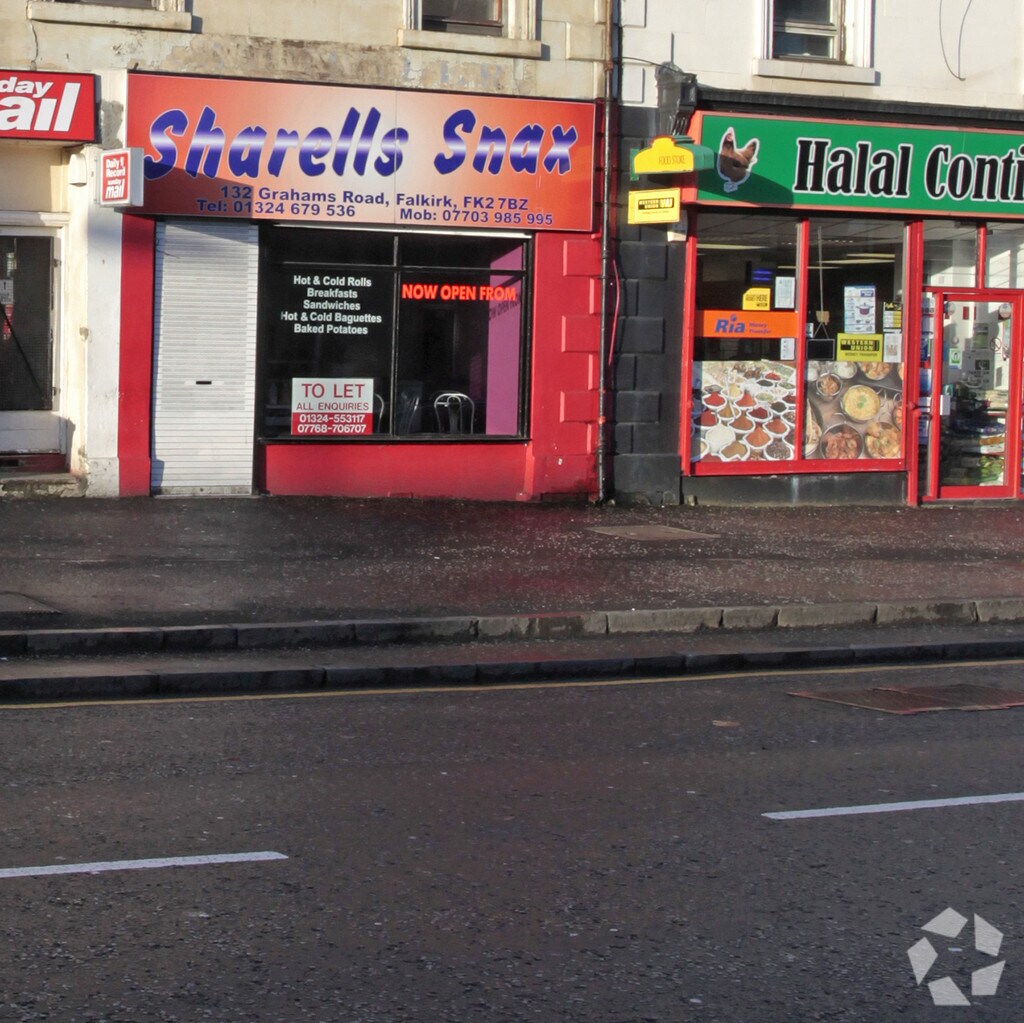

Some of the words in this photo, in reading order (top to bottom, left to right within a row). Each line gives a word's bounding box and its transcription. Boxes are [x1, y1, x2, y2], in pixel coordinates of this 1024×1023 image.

[144, 106, 410, 177] Sharells
[433, 108, 578, 175] Snax
[106, 157, 119, 169] Daily
[793, 137, 914, 198] Halal
[105, 178, 125, 199] mail
[221, 185, 253, 200] 132
[258, 186, 337, 205] Grahams
[342, 189, 390, 208] Road,
[396, 193, 457, 211] Falkirk,
[463, 195, 495, 210] FK2
[497, 197, 529, 211] 7BZ
[197, 199, 228, 213] Tel:
[233, 200, 285, 215] 01324
[290, 203, 321, 217] 679
[325, 204, 356, 218] 536
[400, 208, 437, 222] Mob:
[441, 209, 490, 224] 07703
[494, 211, 523, 225] 985
[526, 212, 554, 226] 995
[293, 275, 312, 286] Hot
[313, 276, 320, 286] &
[323, 276, 345, 287] Cold
[348, 277, 372, 288] Rolls
[307, 288, 358, 299] Breakfasts
[402, 284, 438, 300] NOW
[440, 284, 476, 301] OPEN
[479, 285, 517, 301] FROM
[303, 300, 361, 311] Sandwiches
[281, 311, 297, 321] Hot
[301, 312, 308, 322] &
[310, 312, 332, 323] Cold
[334, 313, 382, 324] Baguettes
[715, 315, 745, 333] Ria
[294, 323, 324, 334] Baked
[327, 324, 369, 335] Potatoes
[302, 383, 324, 398] TO
[334, 383, 365, 398] LET
[297, 402, 314, 411] ALL
[318, 402, 369, 411] ENQUIRIES
[299, 414, 365, 423] 01324-553117
[297, 424, 366, 433] 07768-706707
